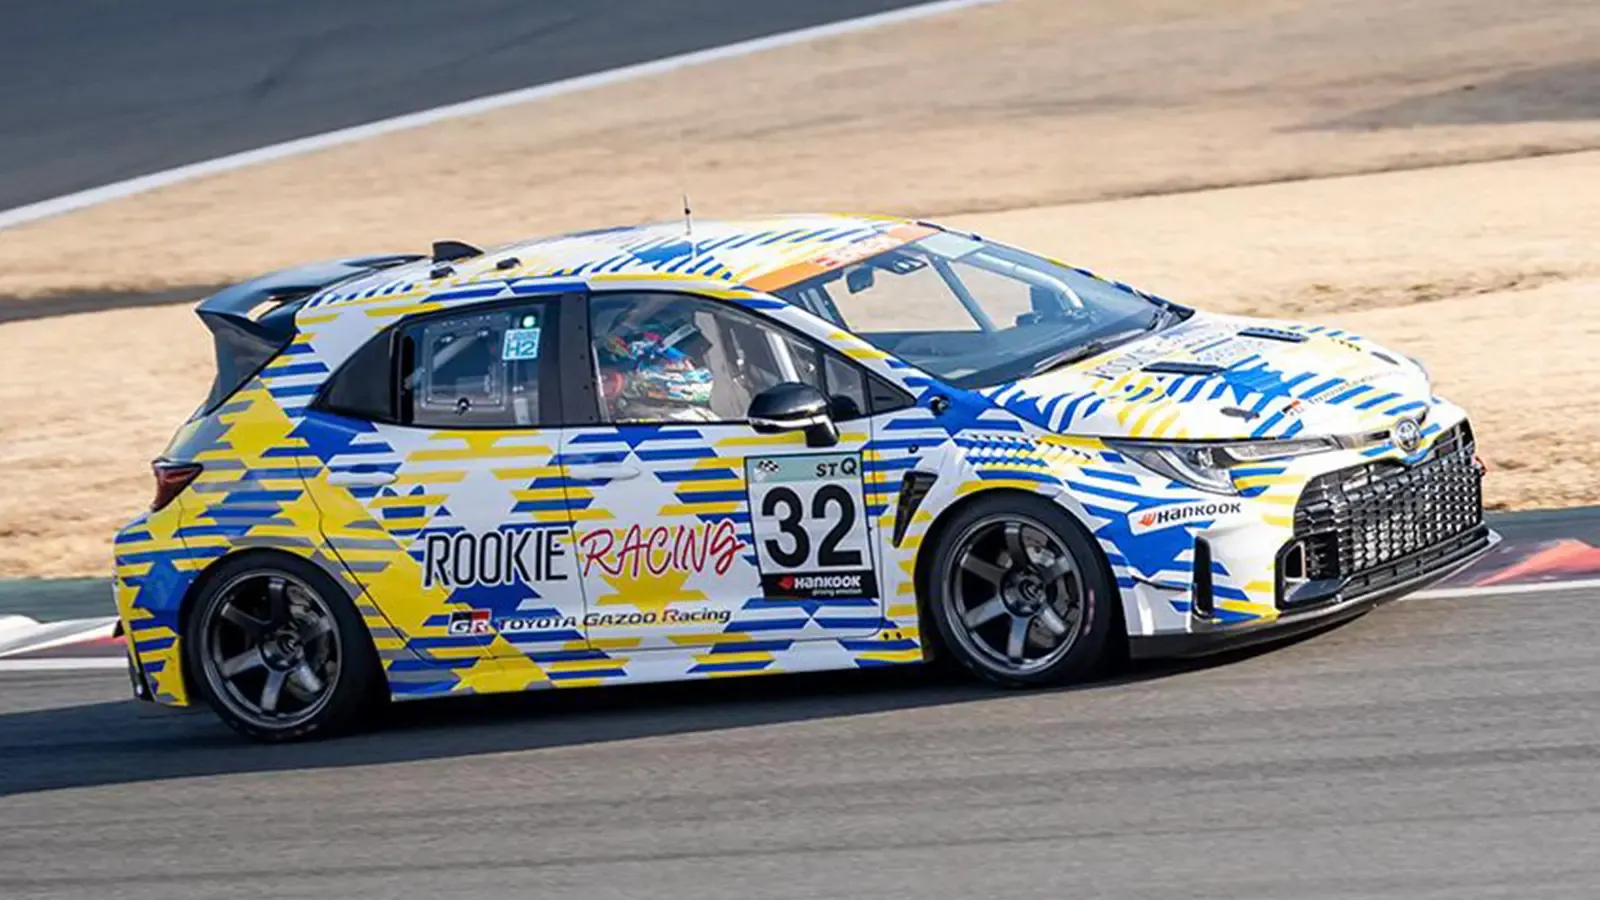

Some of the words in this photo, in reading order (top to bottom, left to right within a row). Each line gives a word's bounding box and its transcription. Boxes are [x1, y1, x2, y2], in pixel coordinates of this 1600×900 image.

[505, 340, 535, 358] H2
[762, 484, 863, 568] 32
[424, 529, 569, 586] ROOKIE
[580, 521, 745, 577] RACING
[451, 618, 489, 633] GR
[500, 617, 577, 630] TOYOTA
[582, 611, 656, 626] GAZOO
[662, 609, 732, 623] Racing
